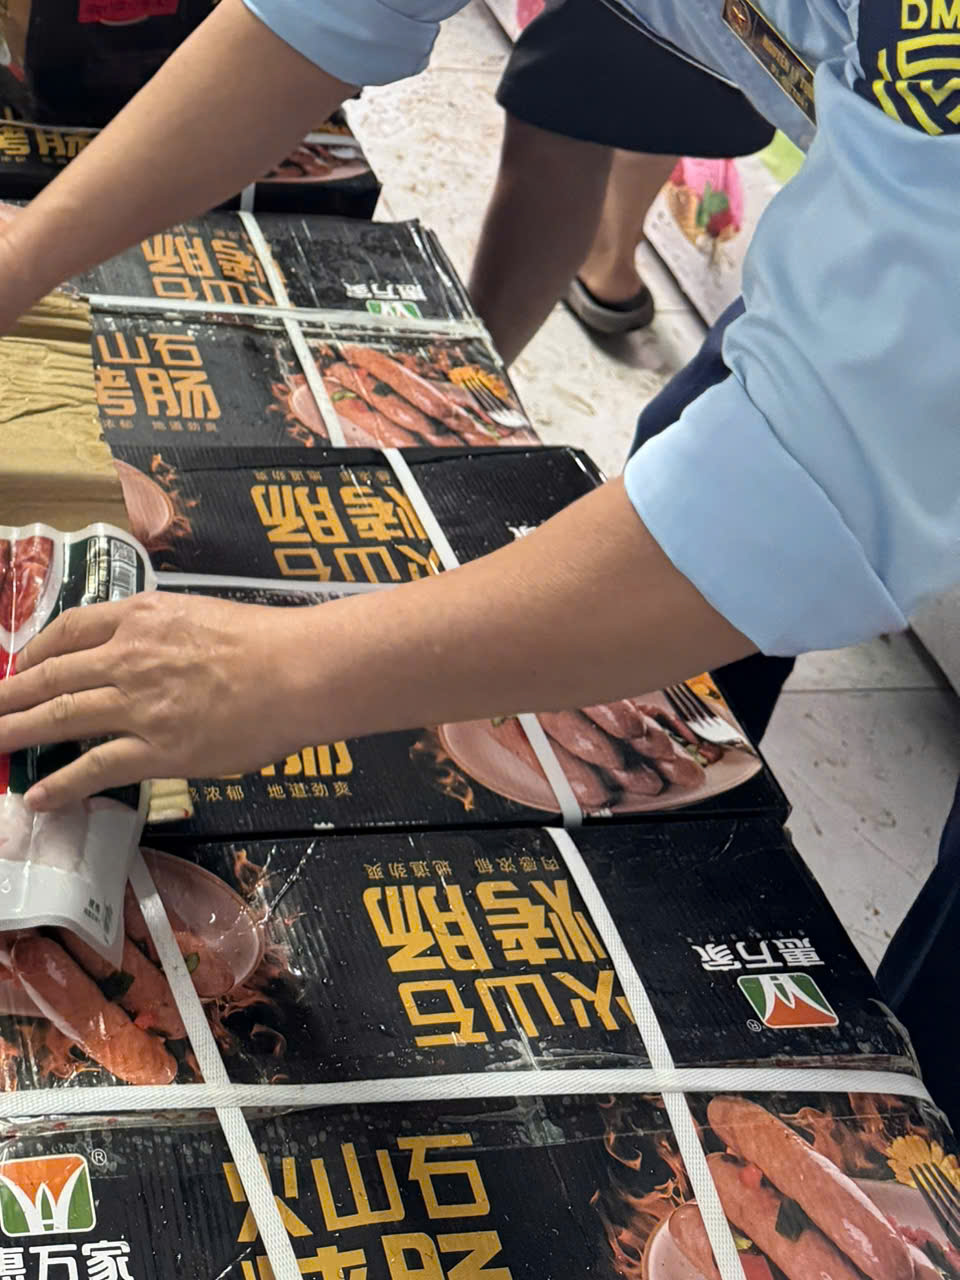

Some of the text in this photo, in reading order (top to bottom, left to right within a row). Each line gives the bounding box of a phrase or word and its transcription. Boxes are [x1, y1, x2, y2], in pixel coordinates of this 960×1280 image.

[267, 780, 353, 800] 地道劲爽
[363, 856, 561, 881] 肉感浓郁 地道劲爽
[362, 879, 609, 973] 烤肠
[691, 937, 826, 972] 惠万家
[397, 970, 638, 1048] 火山石
[221, 1133, 491, 1244] 火山石
